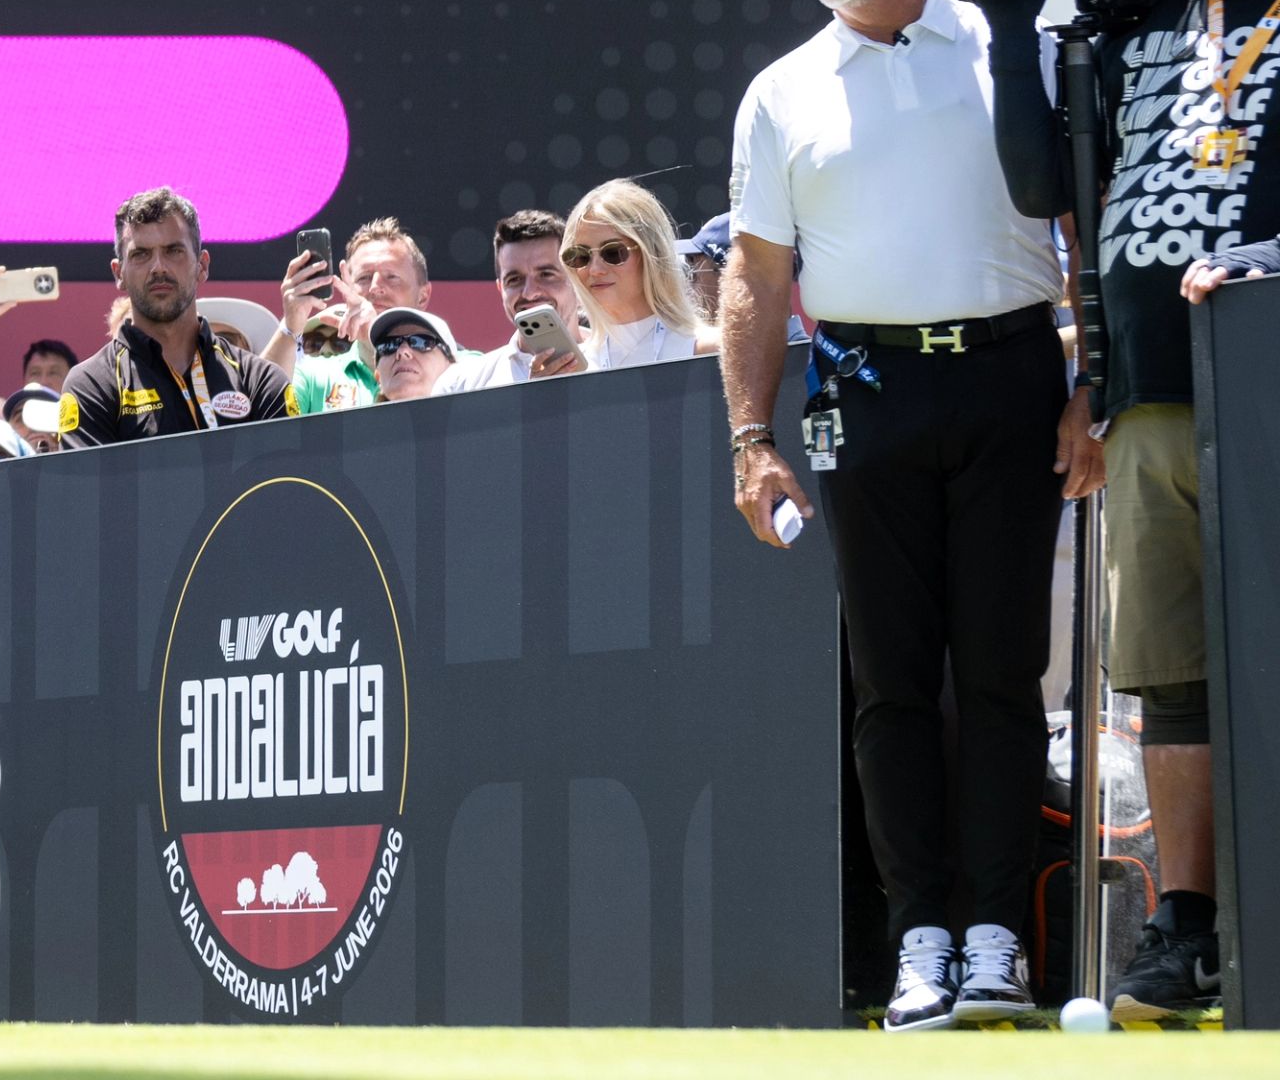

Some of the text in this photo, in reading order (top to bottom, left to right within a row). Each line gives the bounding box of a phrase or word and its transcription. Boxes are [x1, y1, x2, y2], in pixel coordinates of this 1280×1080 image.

[1131, 192, 1248, 229] GOLF
[163, 840, 185, 893] RC
[179, 887, 289, 1015] VALDERRAMA
[300, 964, 328, 1006] 4-7
[331, 905, 376, 984] JUNE
[369, 827, 403, 917] 2026
